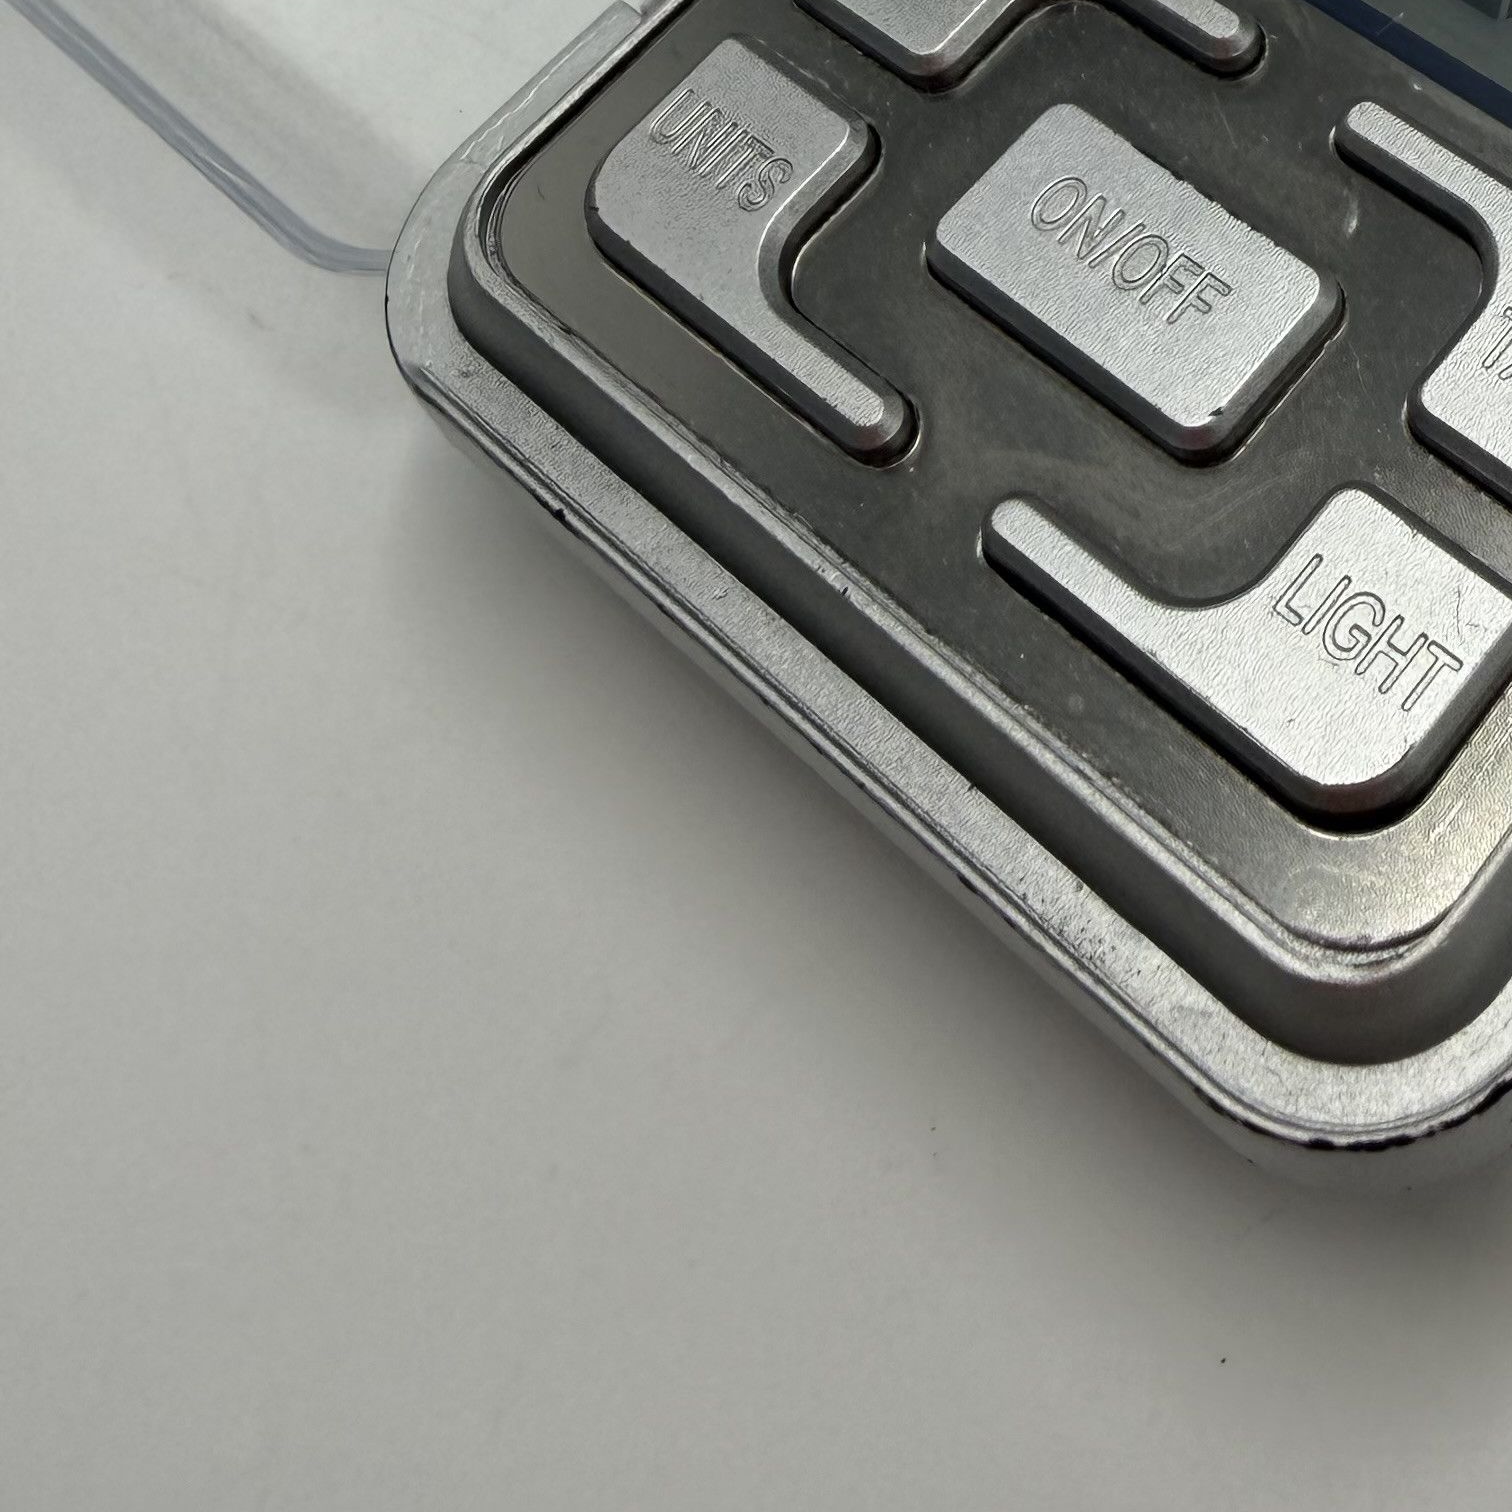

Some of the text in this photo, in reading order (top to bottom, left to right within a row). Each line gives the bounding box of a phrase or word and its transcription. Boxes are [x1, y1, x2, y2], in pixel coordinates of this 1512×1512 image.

[648, 87, 794, 212] UNITS
[1029, 176, 1232, 324] ON/OFF
[1271, 553, 1463, 712] LIGHT
